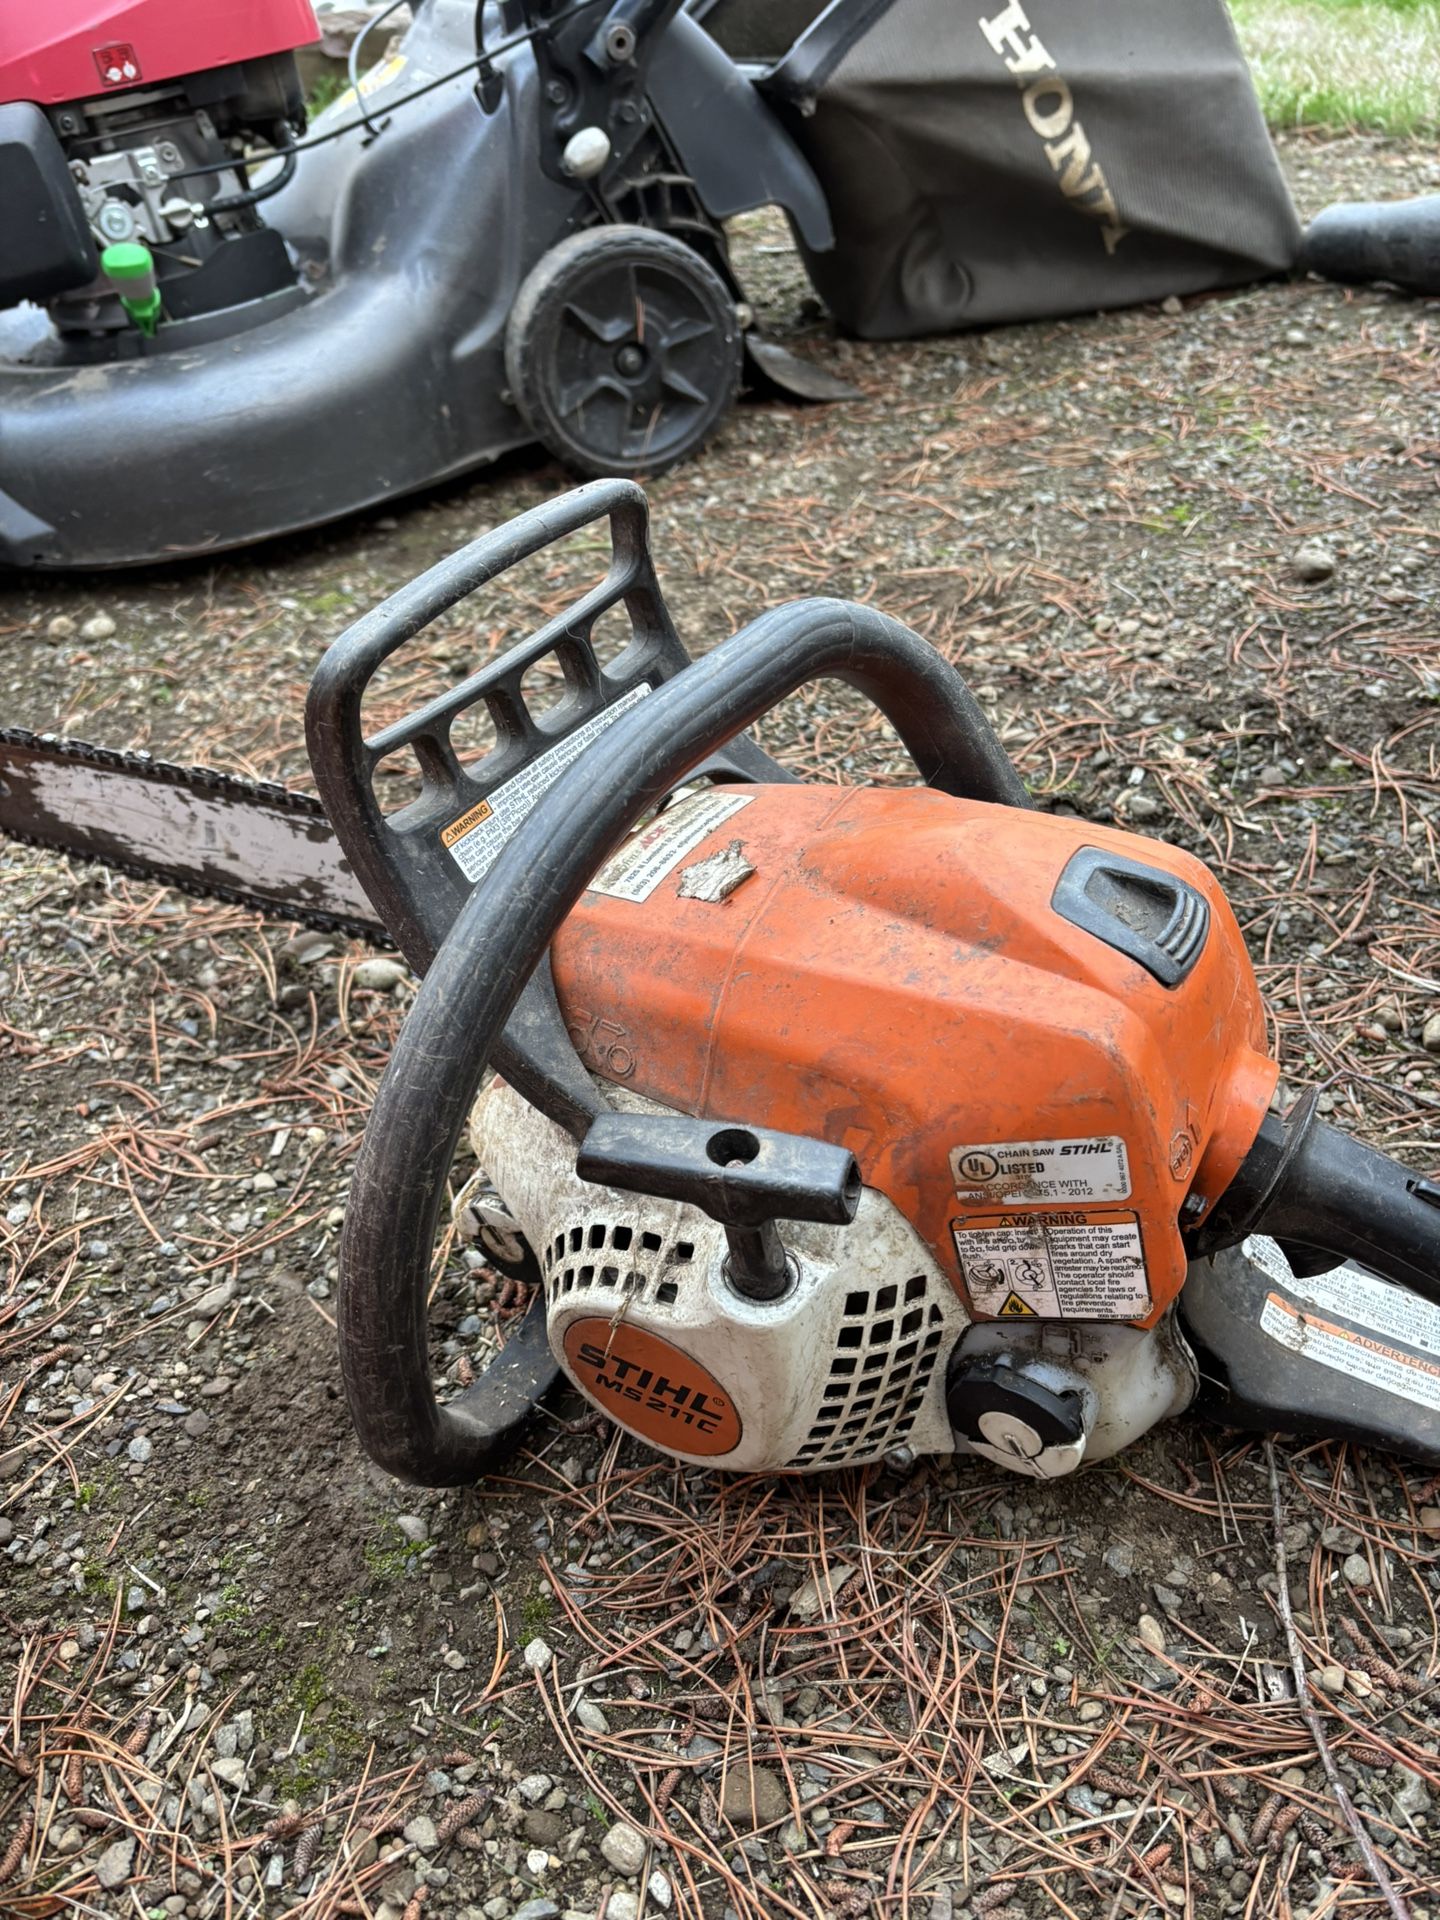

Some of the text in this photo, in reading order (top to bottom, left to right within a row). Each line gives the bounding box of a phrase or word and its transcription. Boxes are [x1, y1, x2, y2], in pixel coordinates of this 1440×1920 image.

[488, 789, 505, 804] Read
[502, 780, 516, 793] and
[514, 768, 531, 784] follow
[530, 763, 539, 772] all
[536, 751, 556, 768] safety
[553, 729, 586, 756] precautions
[589, 705, 618, 729] instruction
[616, 691, 638, 709] manual
[495, 785, 523, 809] improper
[522, 779, 531, 788] use
[529, 770, 542, 782] can
[540, 758, 558, 774] cause
[556, 743, 577, 762] serious
[576, 739, 584, 747] or
[582, 729, 596, 742] fatal
[450, 804, 489, 836] WARNING
[452, 844, 461, 853] of
[458, 826, 484, 848] kickback
[482, 814, 500, 830] injury
[498, 805, 510, 817] use
[508, 791, 528, 809] STIHL
[525, 774, 550, 796] reduced
[456, 844, 474, 859] chain
[485, 822, 500, 837] PM3
[461, 850, 478, 866] This
[477, 844, 487, 854] can
[484, 832, 502, 848] cause
[501, 823, 512, 834] the
[510, 815, 522, 827] bar
[641, 825, 668, 850] ACE
[465, 854, 488, 873] serious
[486, 849, 494, 857] or
[470, 865, 486, 879] wear
[623, 869, 642, 883] 7825
[637, 862, 646, 870] N
[630, 877, 650, 896] (503)
[967, 1158, 991, 1176] UL
[997, 1150, 1030, 1159] CHAIN
[1032, 1148, 1055, 1157] SAW
[1059, 1143, 1112, 1156] STIHL
[1000, 1162, 1045, 1176] LISTED
[1059, 1179, 1088, 1188] WITH
[1068, 1187, 1094, 1197] 2012
[1012, 1214, 1088, 1227] WARNING
[968, 1230, 996, 1240] tighten
[996, 1230, 1014, 1239] cap:
[1047, 1227, 1087, 1236] Operation
[1097, 1226, 1113, 1234] this
[959, 1237, 975, 1245] with
[1050, 1233, 1137, 1244] equipment may create
[1002, 1245, 1018, 1253] grip
[1050, 1242, 1076, 1250] sparks
[1077, 1242, 1093, 1250] that
[1070, 1249, 1098, 1257] around
[1099, 1249, 1113, 1257] dry
[1052, 1257, 1095, 1265] vegetation.
[1083, 1265, 1099, 1274] may
[1058, 1286, 1094, 1294] agencies
[1060, 1293, 1103, 1301] regulations
[1104, 1293, 1134, 1301] relating
[576, 1343, 723, 1421] STIHL
[595, 1373, 719, 1434] MS 211C
